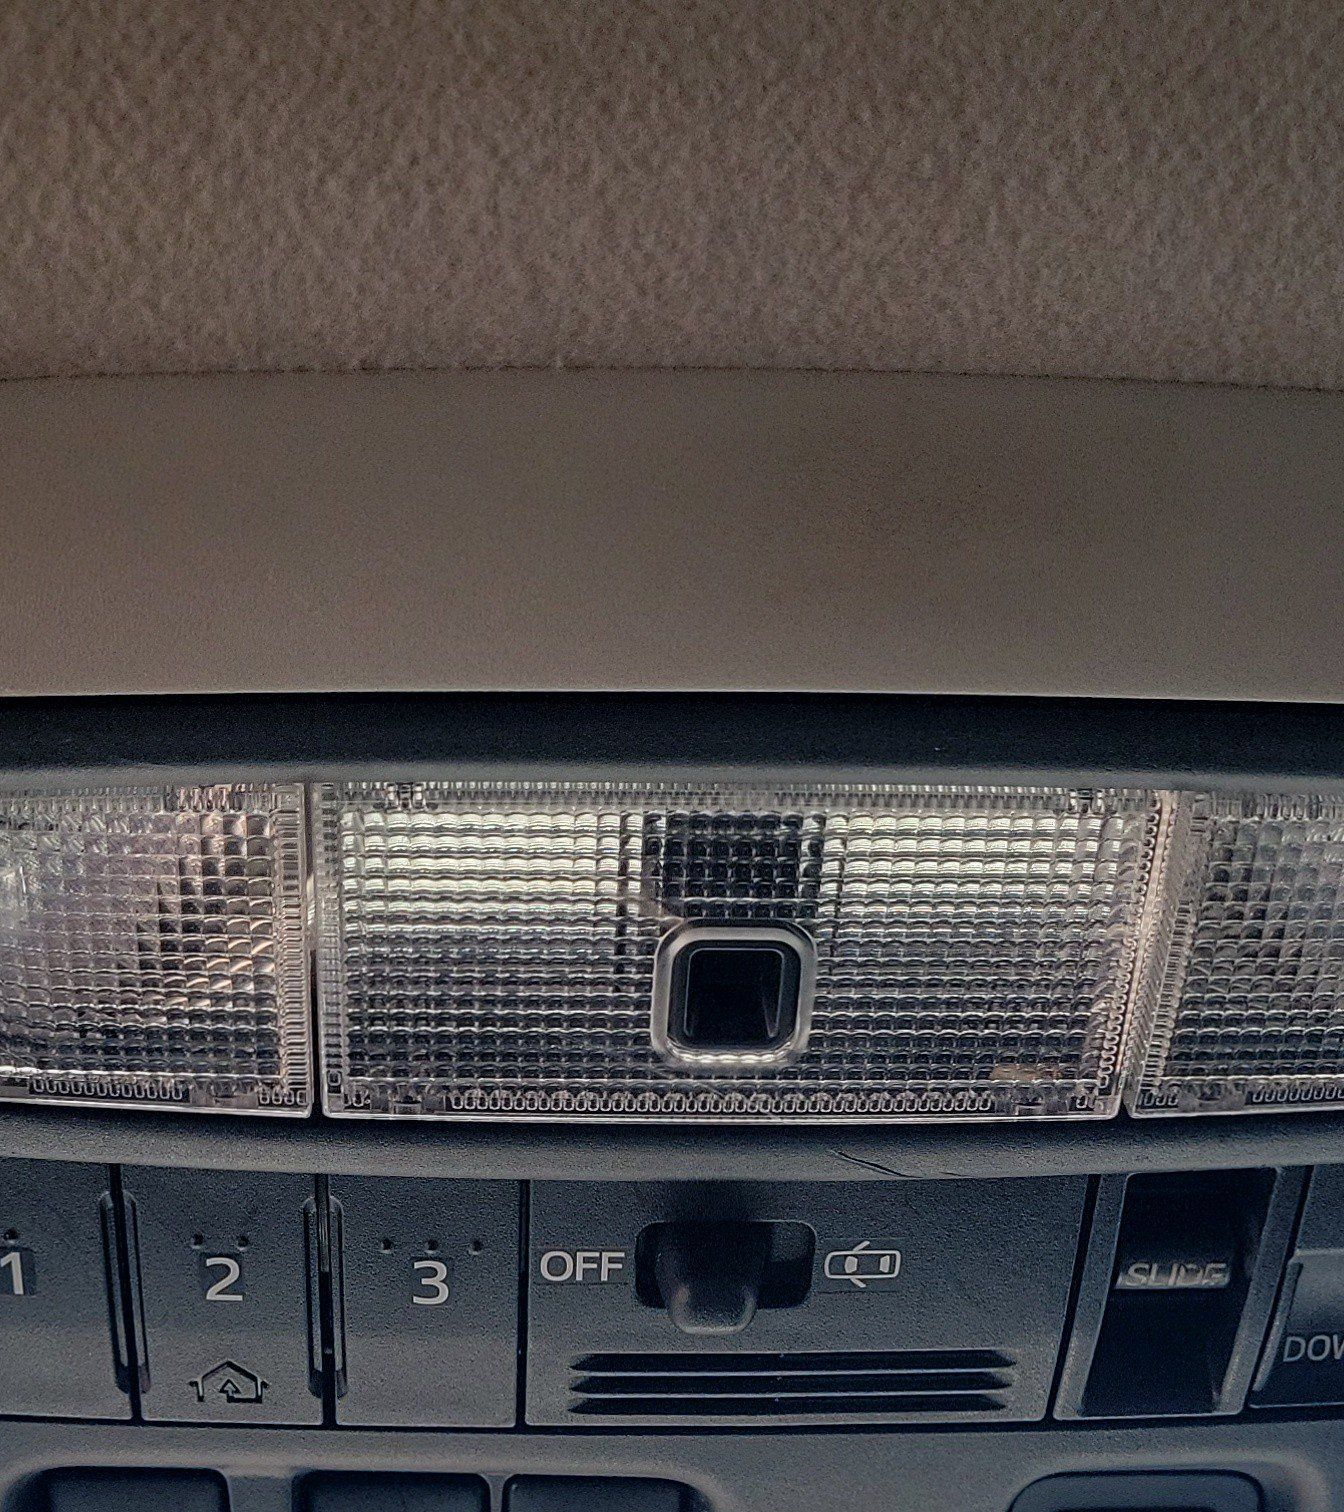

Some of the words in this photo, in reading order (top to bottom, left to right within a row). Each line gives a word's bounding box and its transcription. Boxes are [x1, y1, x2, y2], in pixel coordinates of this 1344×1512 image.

[204, 1257, 244, 1302] 2
[412, 1260, 449, 1305] 3
[540, 1251, 626, 1282] OFF
[1124, 1262, 1229, 1287] SLIDE
